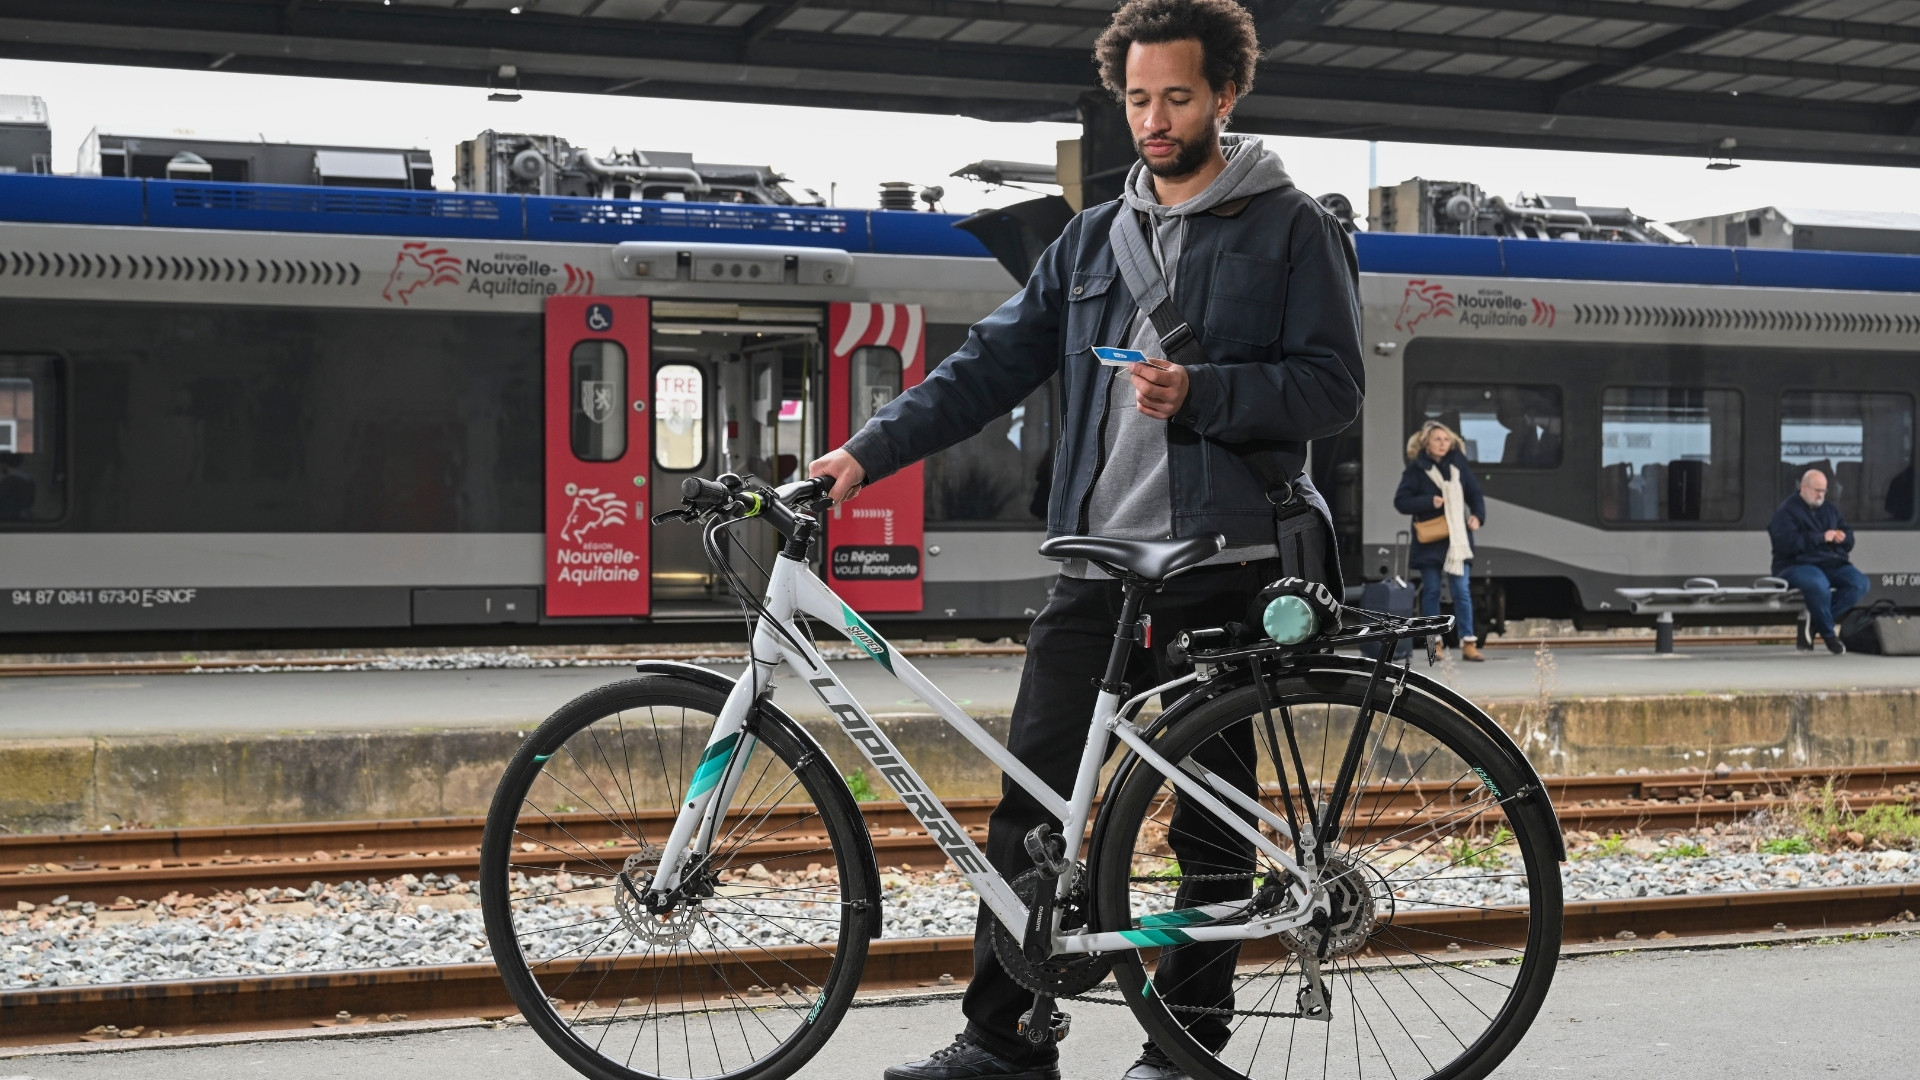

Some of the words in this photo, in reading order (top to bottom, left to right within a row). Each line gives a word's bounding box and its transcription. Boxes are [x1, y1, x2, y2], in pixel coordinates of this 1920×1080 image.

[494, 251, 528, 261] RÉGION
[466, 258, 558, 276] Nouvelle-
[467, 277, 558, 299] Aquitaine
[1457, 294, 1527, 309] Nouvelle-
[1459, 310, 1528, 329] Aquitaine
[655, 377, 697, 394] TRE
[583, 541, 614, 550] RÉGION
[557, 549, 640, 564] Nouvelle-
[834, 552, 849, 562] La
[850, 550, 890, 565] Région
[557, 565, 640, 587] Aquitaine
[834, 565, 860, 575] vous
[862, 563, 918, 577] transporte
[12, 590, 32, 605] 94
[35, 590, 55, 605] 87
[58, 590, 93, 604] 0841
[99, 590, 139, 604] 673-0
[850, 626, 883, 653] SHAPER
[809, 678, 988, 875] LAPIERRE
[1473, 767, 1501, 797] SHAPER
[808, 991, 826, 1025] SHAPER
